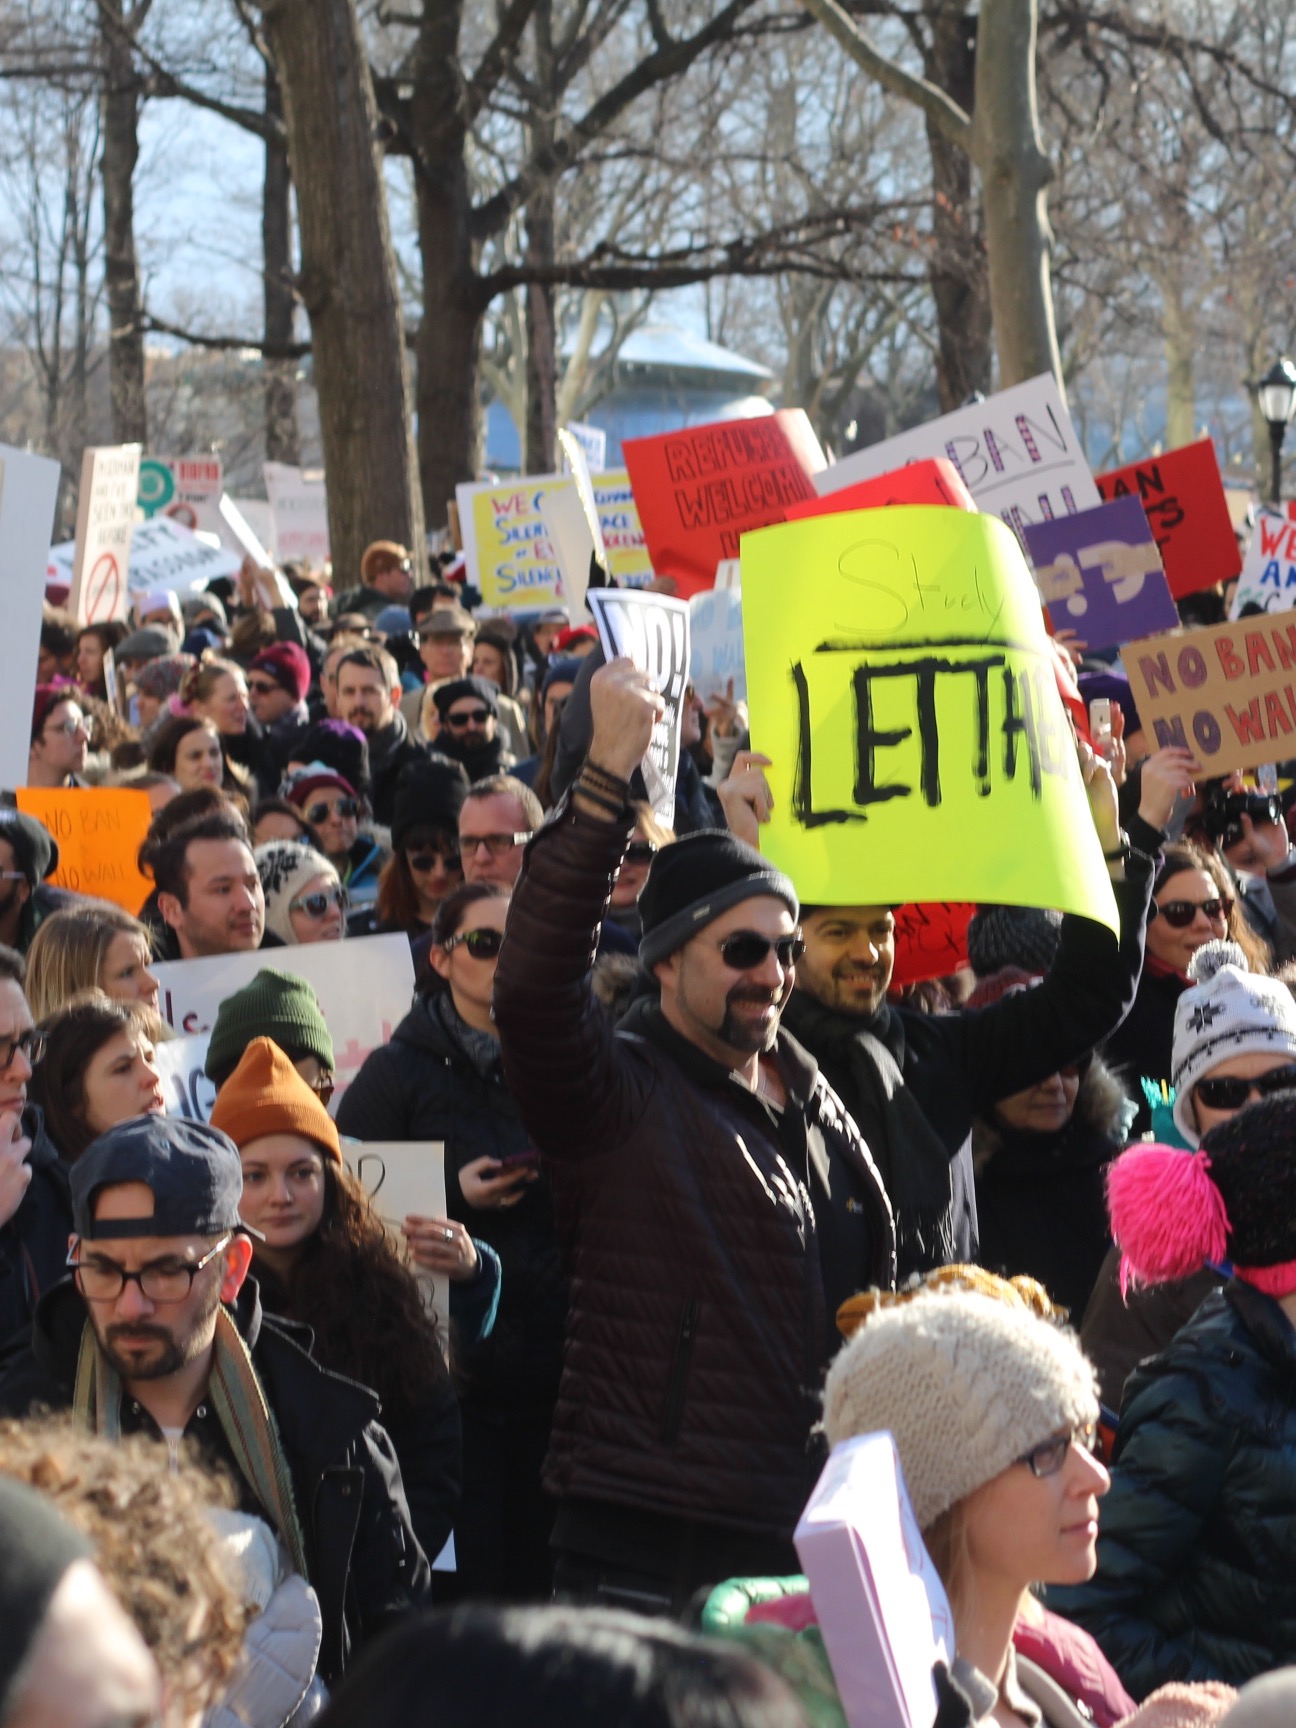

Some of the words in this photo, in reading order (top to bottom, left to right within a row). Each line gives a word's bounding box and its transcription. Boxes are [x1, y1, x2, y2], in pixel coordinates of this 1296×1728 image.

[1138, 645, 1208, 699] NO
[1152, 709, 1222, 758] NO
[45, 807, 72, 840] NO
[56, 865, 80, 891] NO
